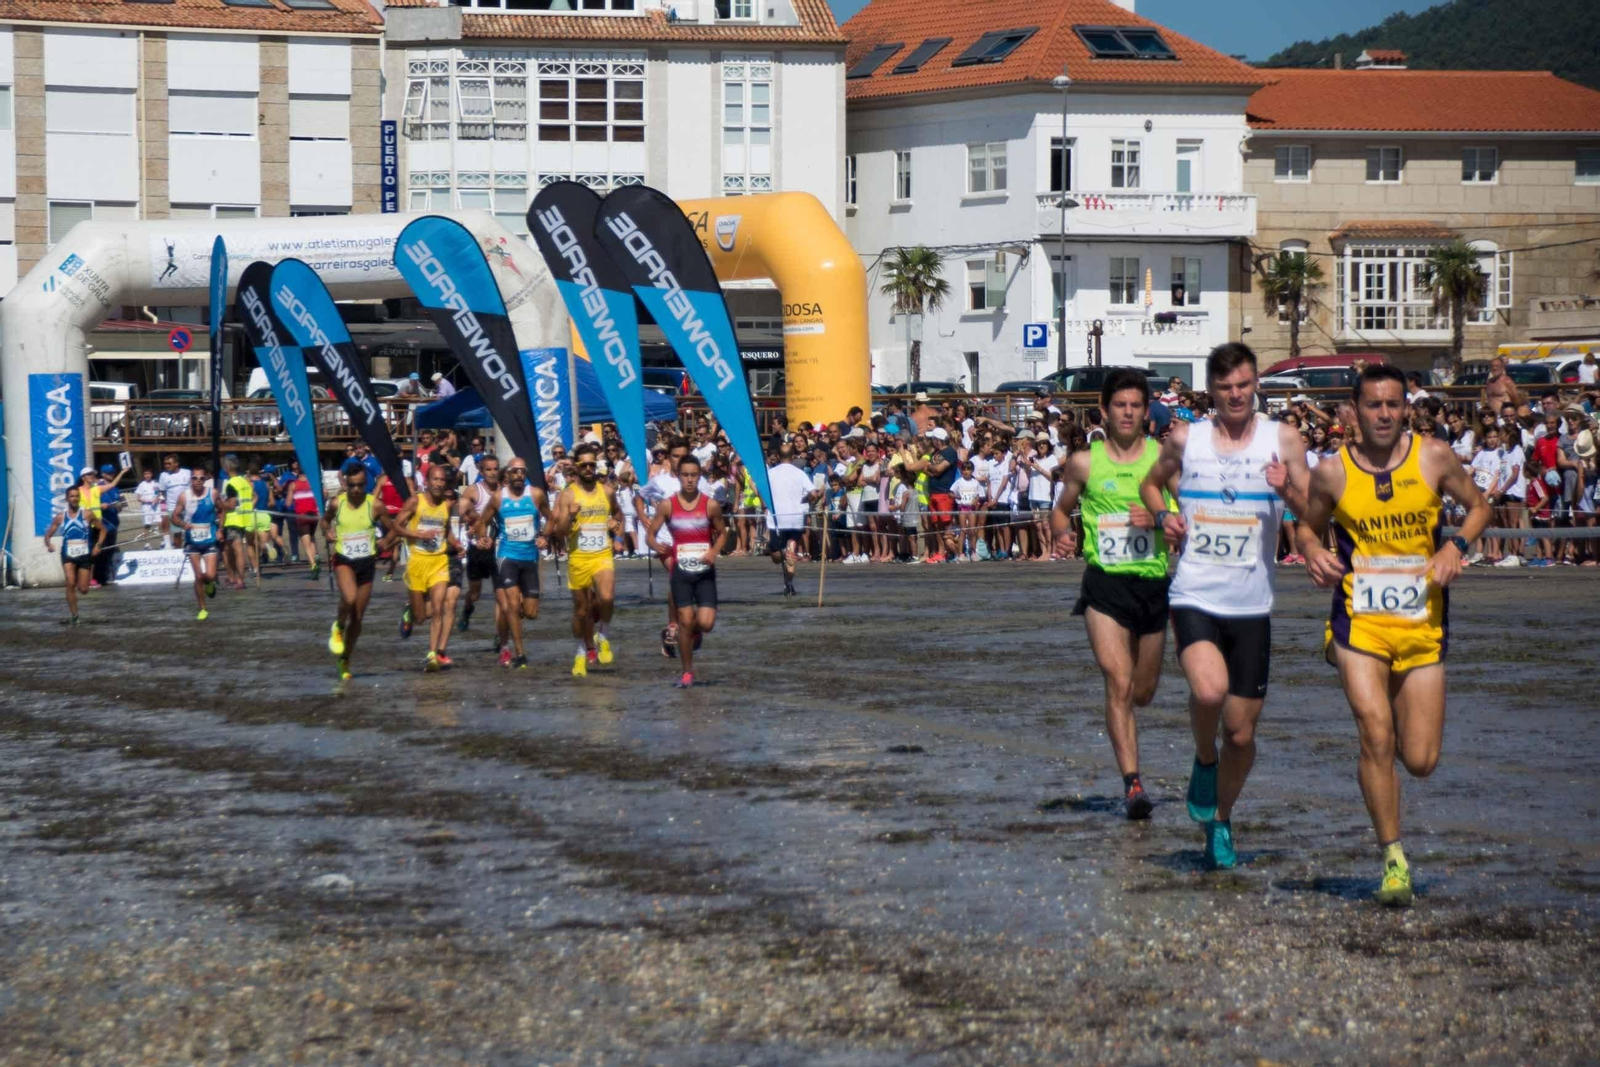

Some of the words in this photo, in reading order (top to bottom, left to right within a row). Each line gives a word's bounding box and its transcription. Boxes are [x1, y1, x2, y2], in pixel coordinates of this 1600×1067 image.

[384, 125, 395, 185] PUERTO
[385, 192, 395, 213] PE
[83, 266, 110, 293] XUNTA
[1027, 326, 1043, 345] P
[512, 527, 528, 538] 94
[580, 535, 604, 547] 233
[345, 542, 369, 555] 242
[1103, 535, 1148, 555] 270
[1194, 533, 1250, 557] 257
[1361, 586, 1419, 611] 162
